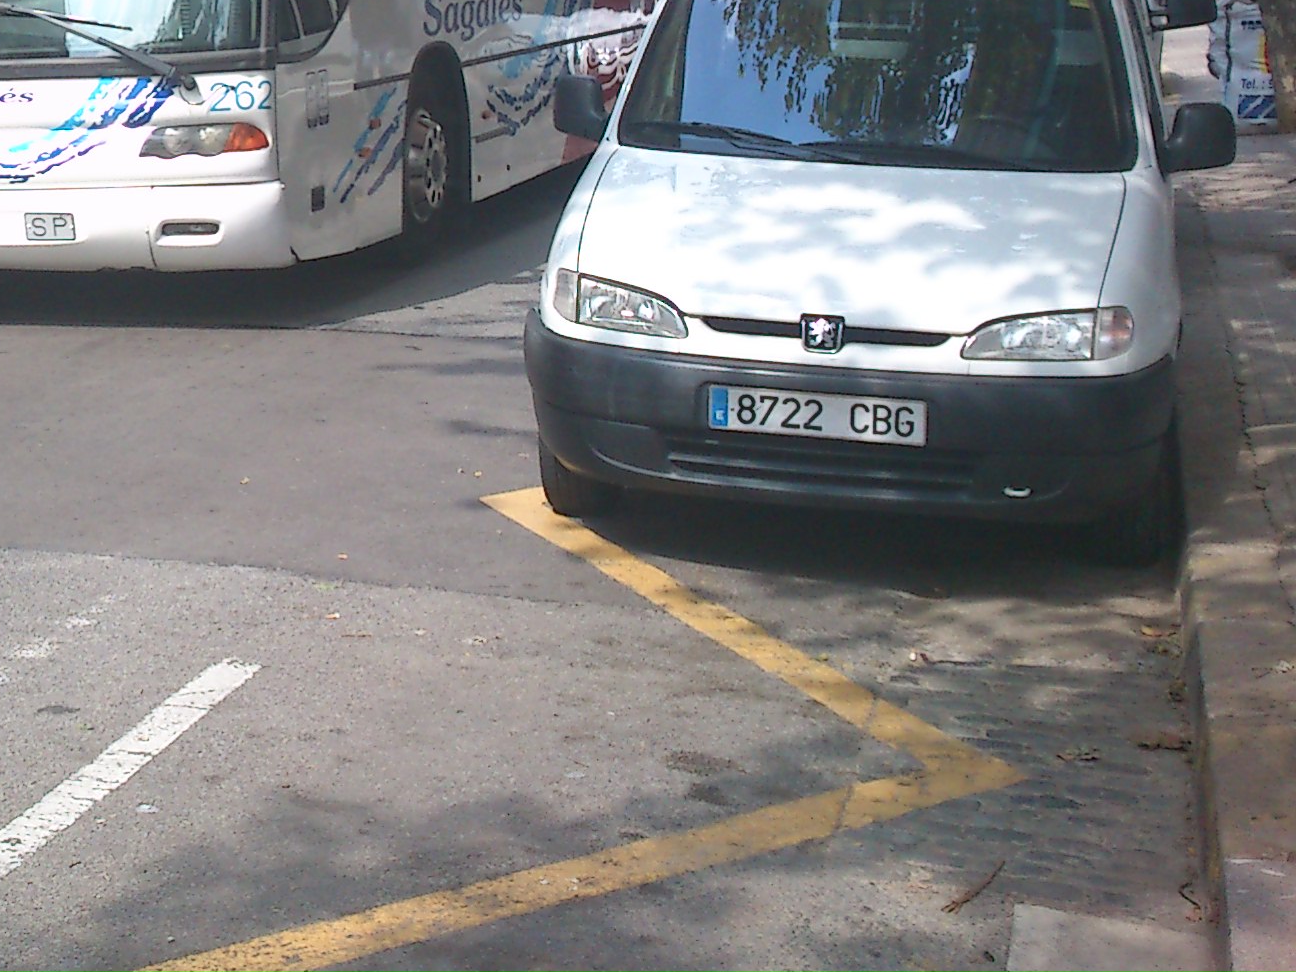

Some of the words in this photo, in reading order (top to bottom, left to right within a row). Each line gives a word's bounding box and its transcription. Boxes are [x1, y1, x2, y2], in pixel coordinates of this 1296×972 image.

[210, 80, 273, 112] 262
[736, 393, 824, 432] 8722
[849, 402, 916, 438] CBG
